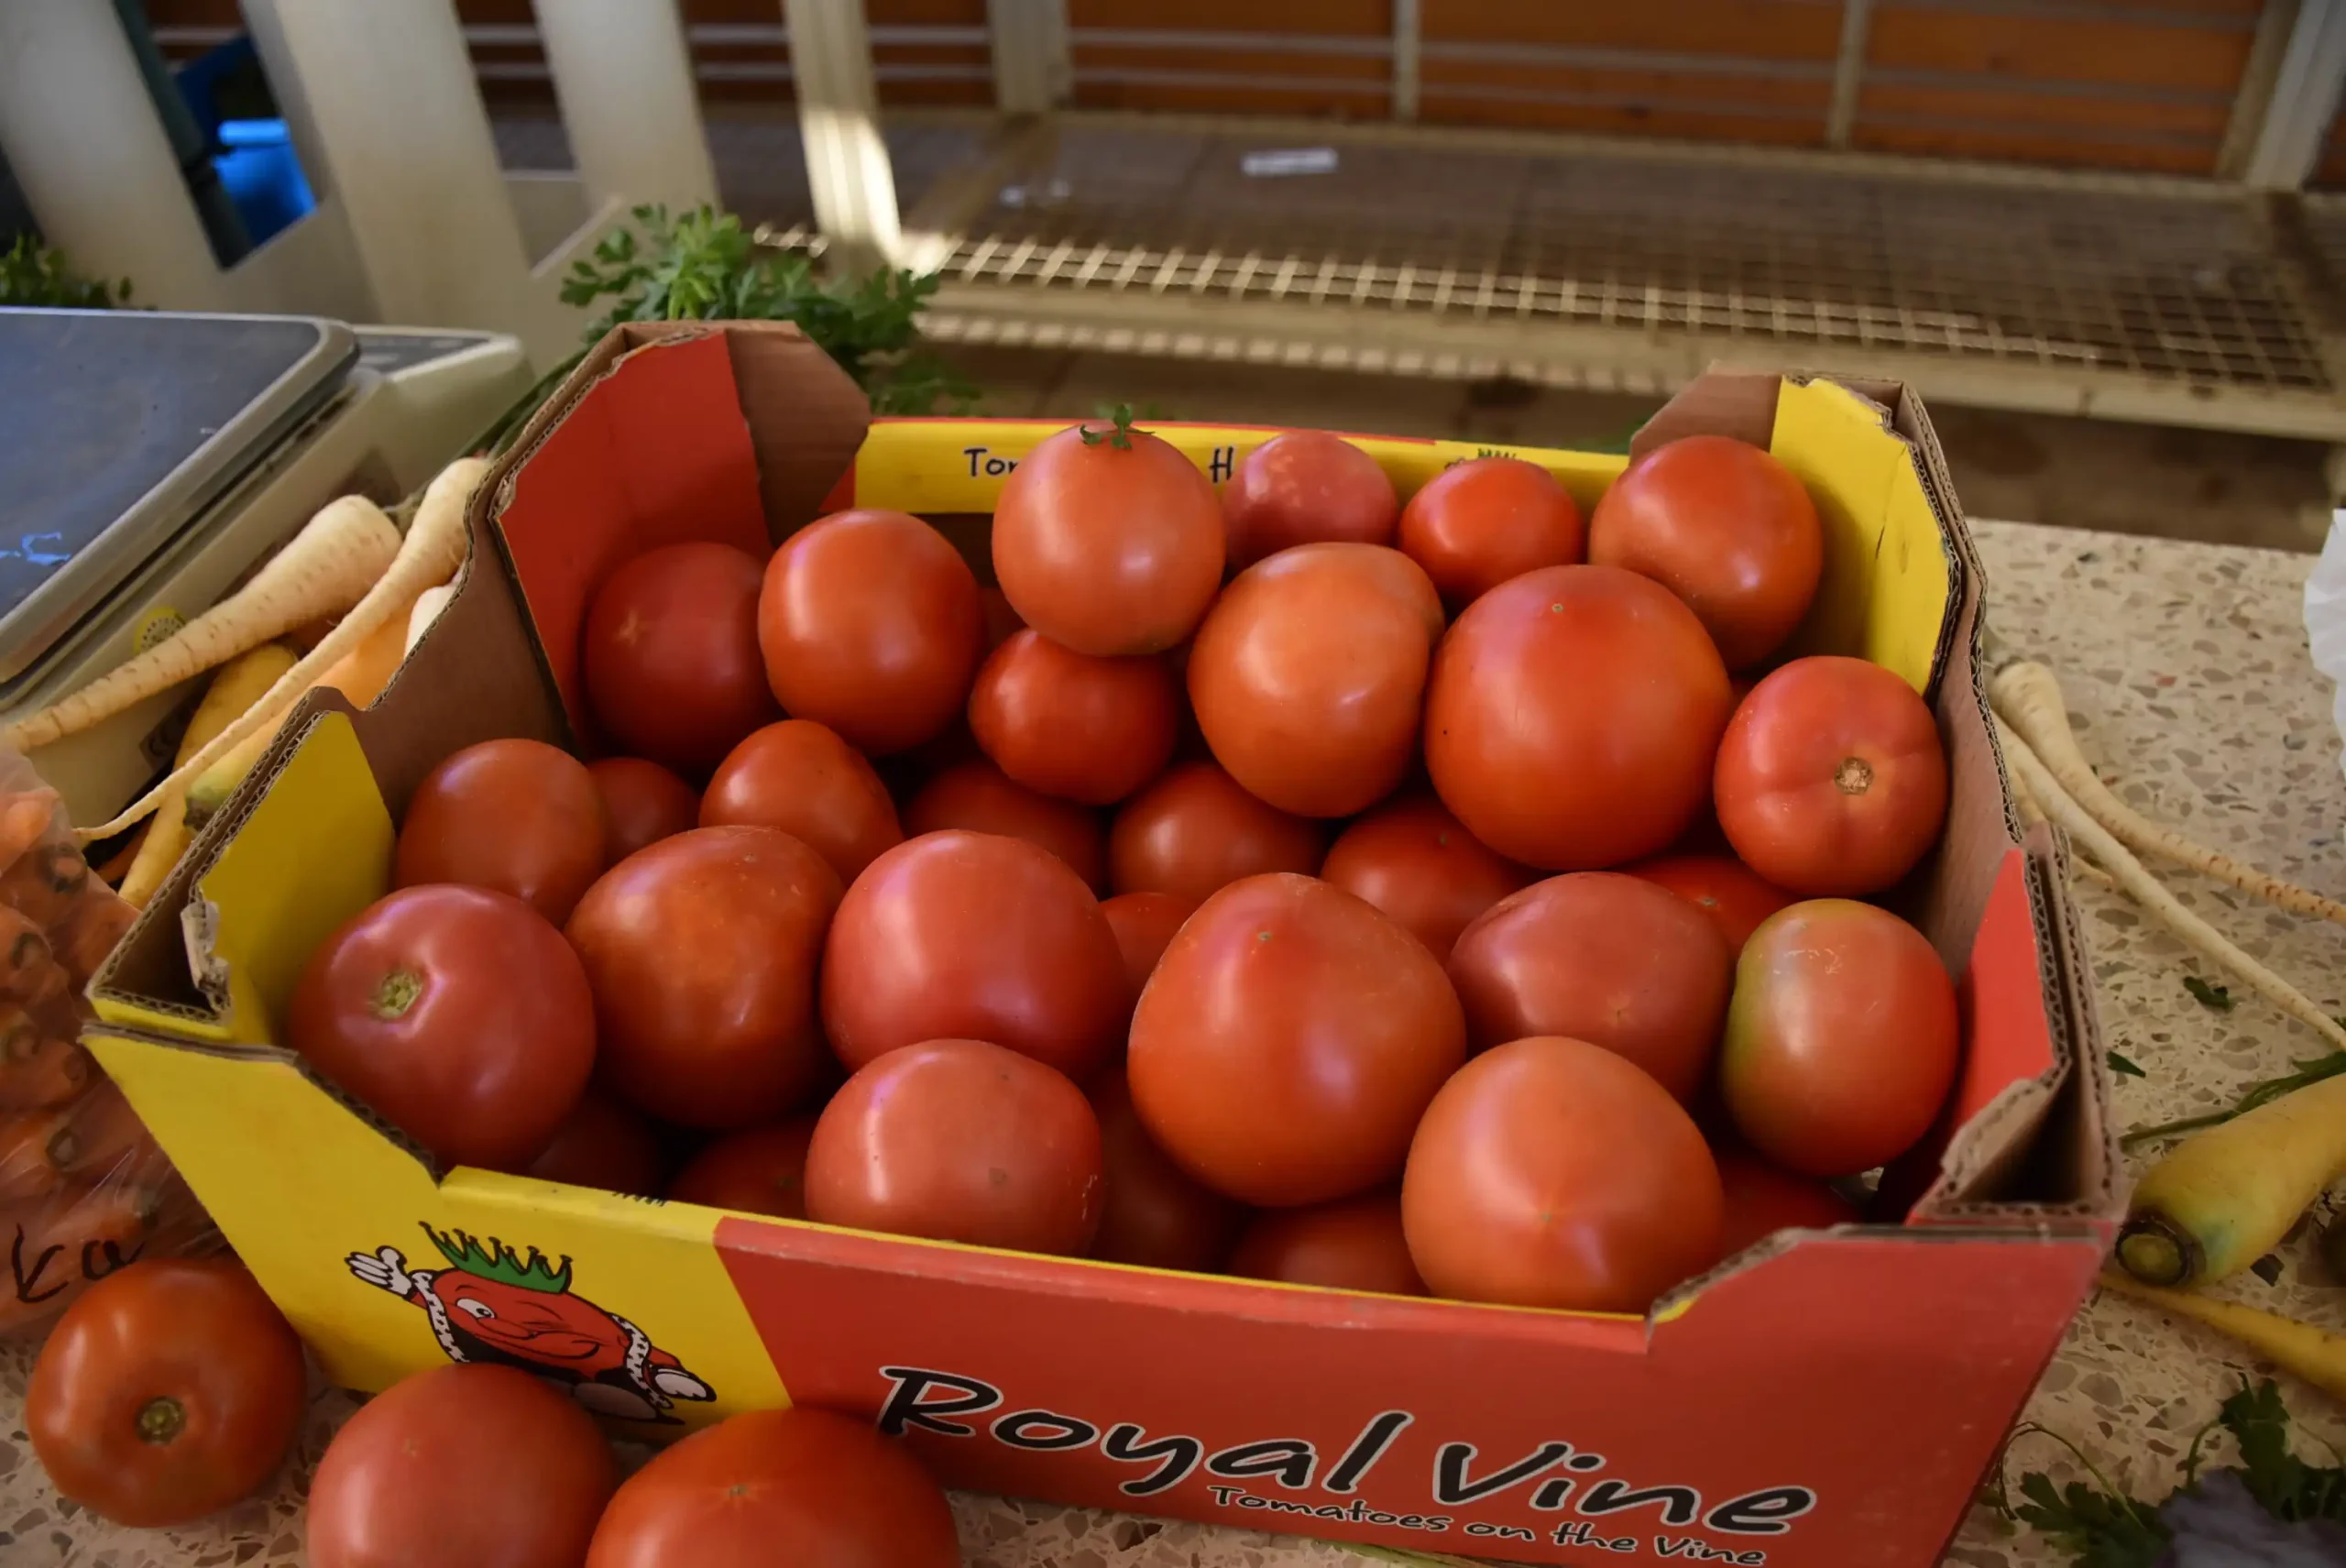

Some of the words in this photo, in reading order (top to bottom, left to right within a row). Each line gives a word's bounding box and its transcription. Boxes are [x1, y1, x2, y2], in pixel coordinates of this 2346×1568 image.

[877, 1365, 1415, 1496] Royal
[1432, 1441, 1817, 1535] Vine
[1207, 1485, 1454, 1531] Tomatoes
[1464, 1521, 1536, 1541] on
[1550, 1522, 1639, 1553] the
[1654, 1535, 1767, 1566] Vine
